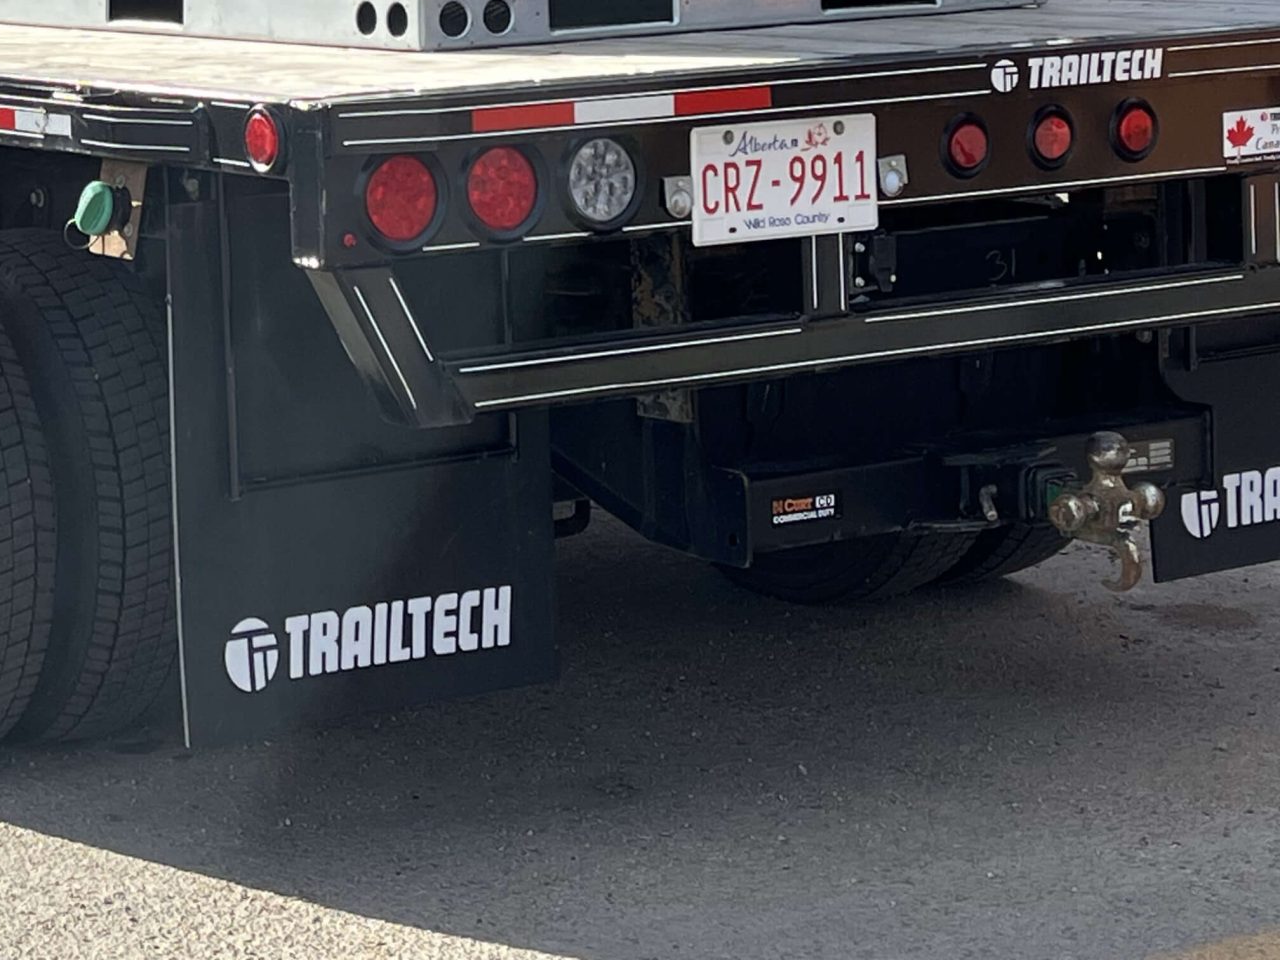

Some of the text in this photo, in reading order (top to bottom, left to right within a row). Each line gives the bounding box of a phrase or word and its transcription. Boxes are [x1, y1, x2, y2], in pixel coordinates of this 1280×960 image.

[1028, 48, 1163, 89] TRAILTECH
[729, 131, 791, 157] Alberta
[701, 150, 871, 215] CRZ-9911
[744, 217, 766, 230] Wild
[768, 216, 792, 228] Rose
[285, 585, 512, 679] TRAILTECH
